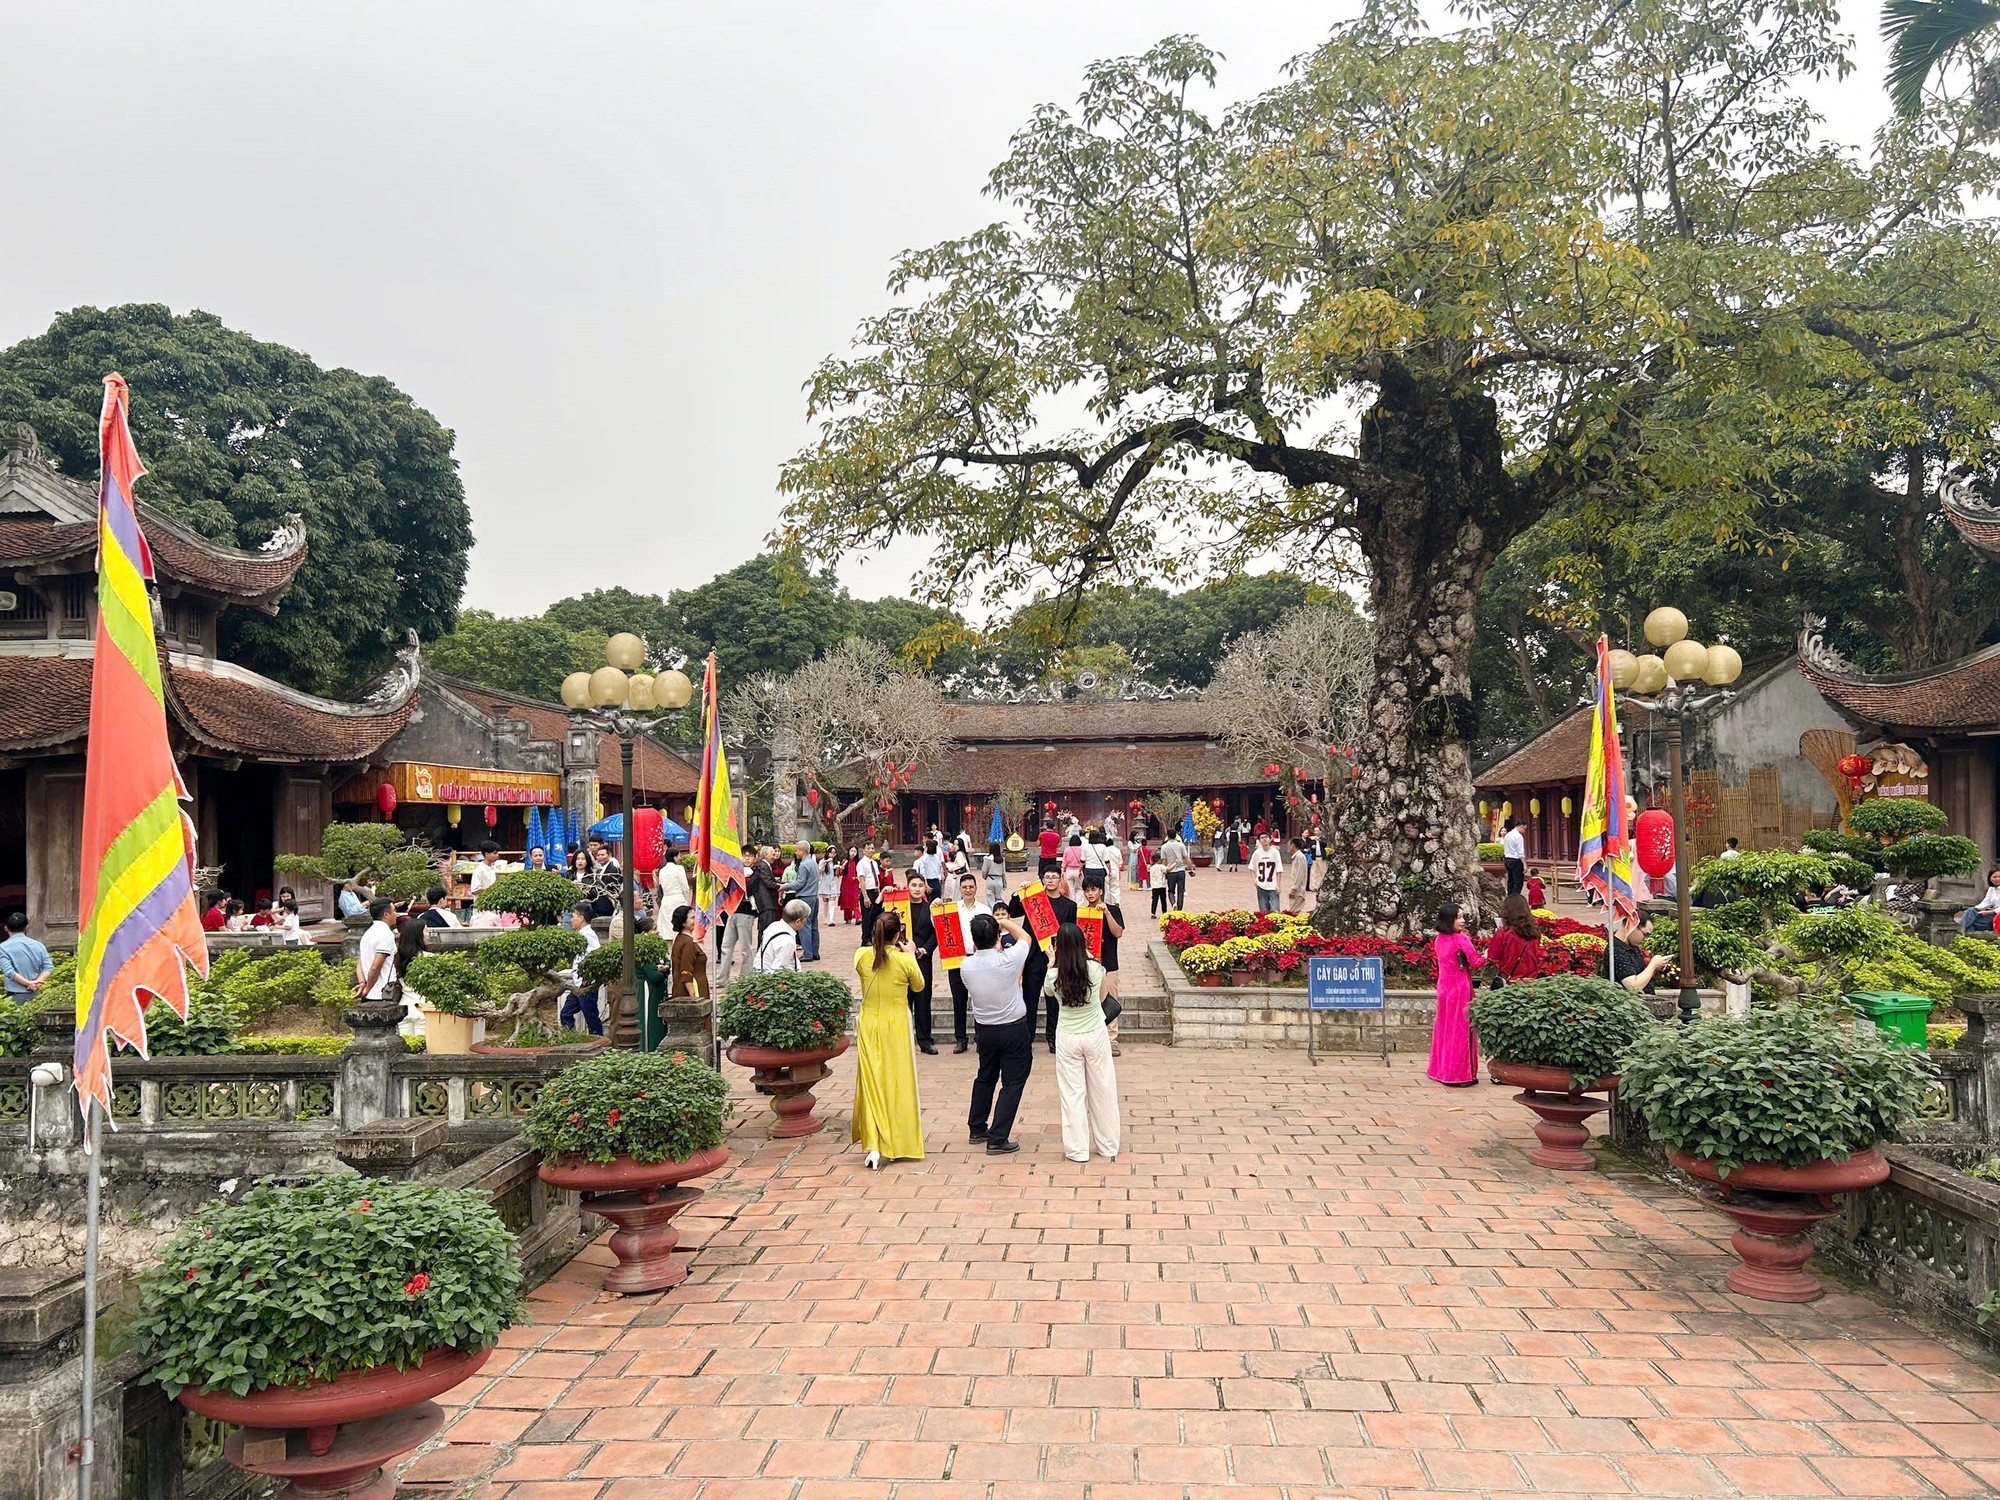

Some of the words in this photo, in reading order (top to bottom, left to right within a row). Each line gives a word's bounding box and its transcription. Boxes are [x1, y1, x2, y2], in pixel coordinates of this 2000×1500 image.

[1258, 862, 1276, 883] 97
[1316, 964, 1331, 981] CÂY
[1332, 967, 1348, 984] GẠO
[1349, 961, 1360, 981] CỔ
[1360, 967, 1376, 984] THỤ
